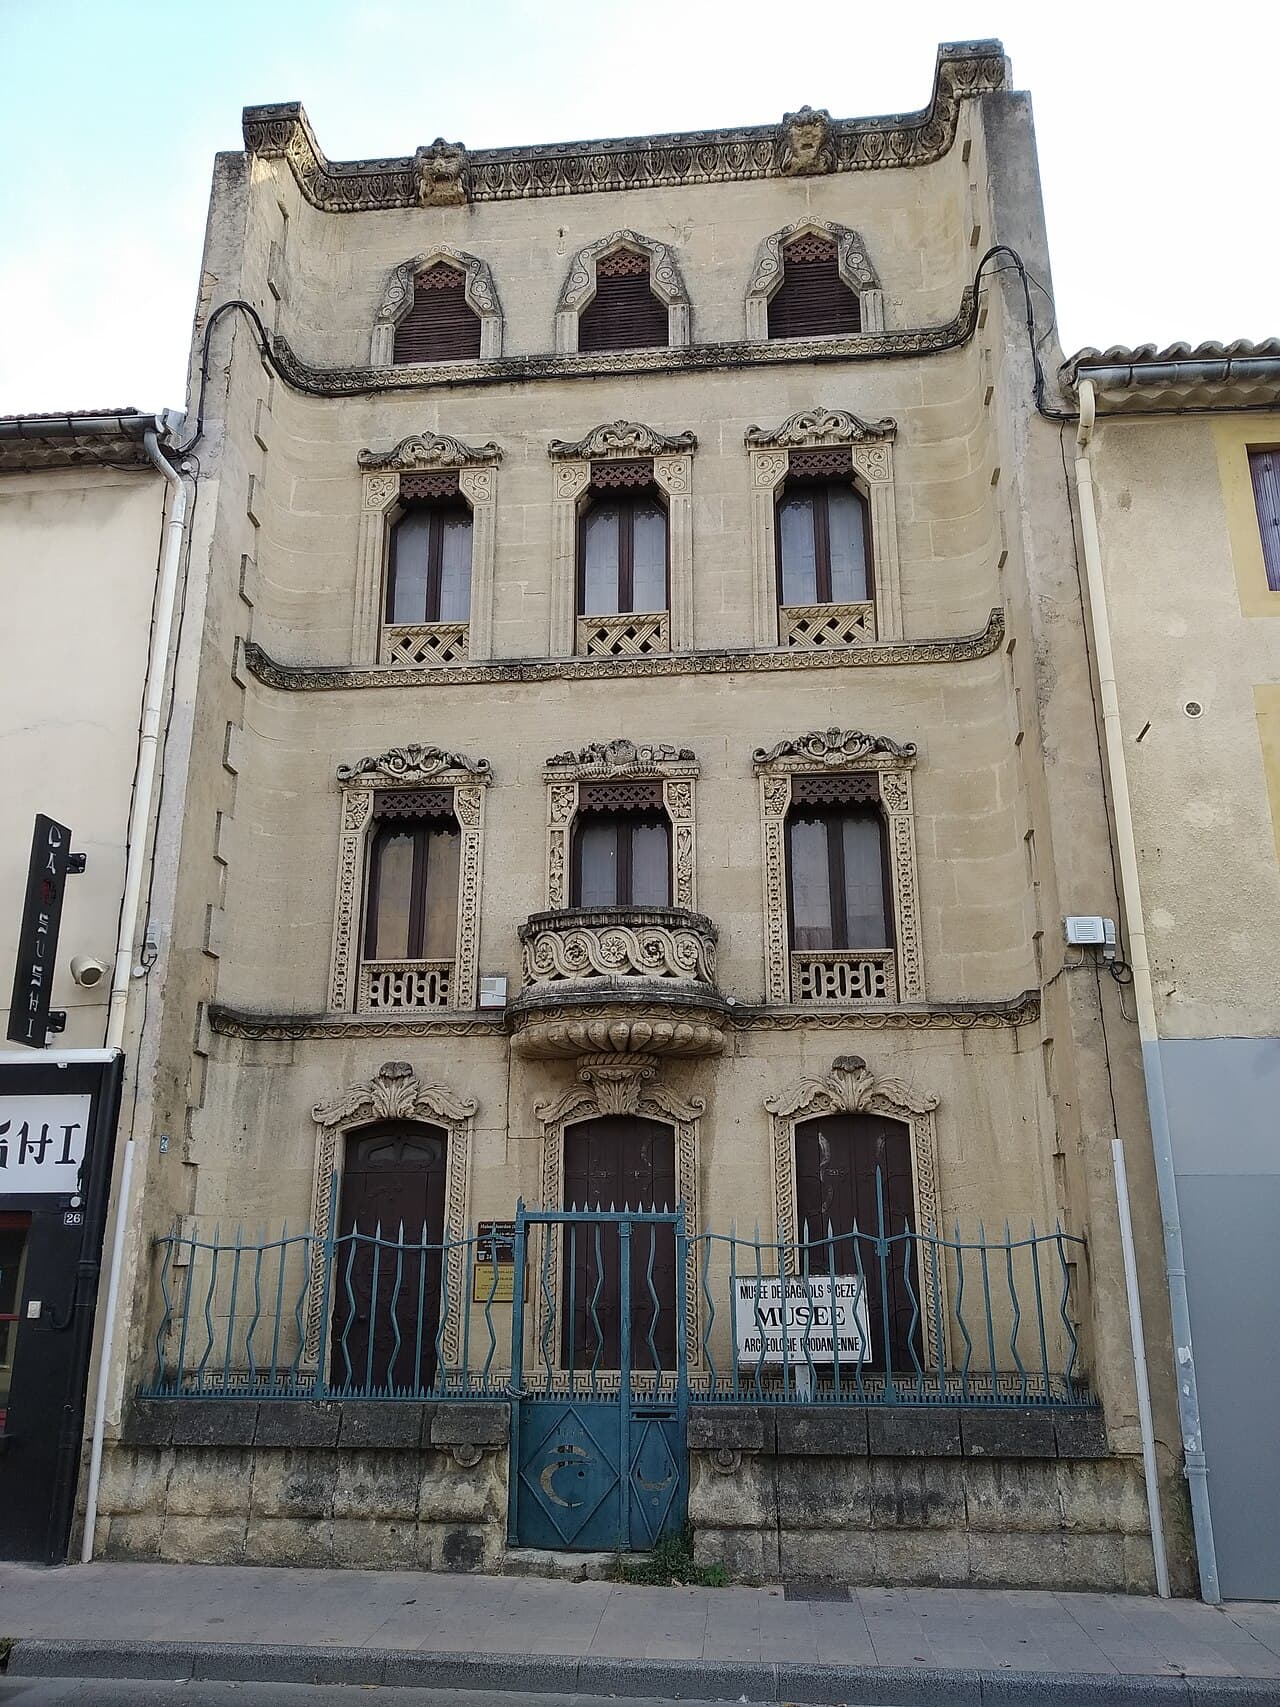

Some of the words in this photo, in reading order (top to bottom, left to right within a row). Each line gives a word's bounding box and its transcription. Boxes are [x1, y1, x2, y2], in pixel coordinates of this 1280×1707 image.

[66, 1213, 81, 1224] 26
[771, 1285, 783, 1299] DE
[835, 1284, 856, 1298] CEZE
[753, 1306, 846, 1327] MUSEE
[800, 1337, 860, 1352] RHODANENNE
